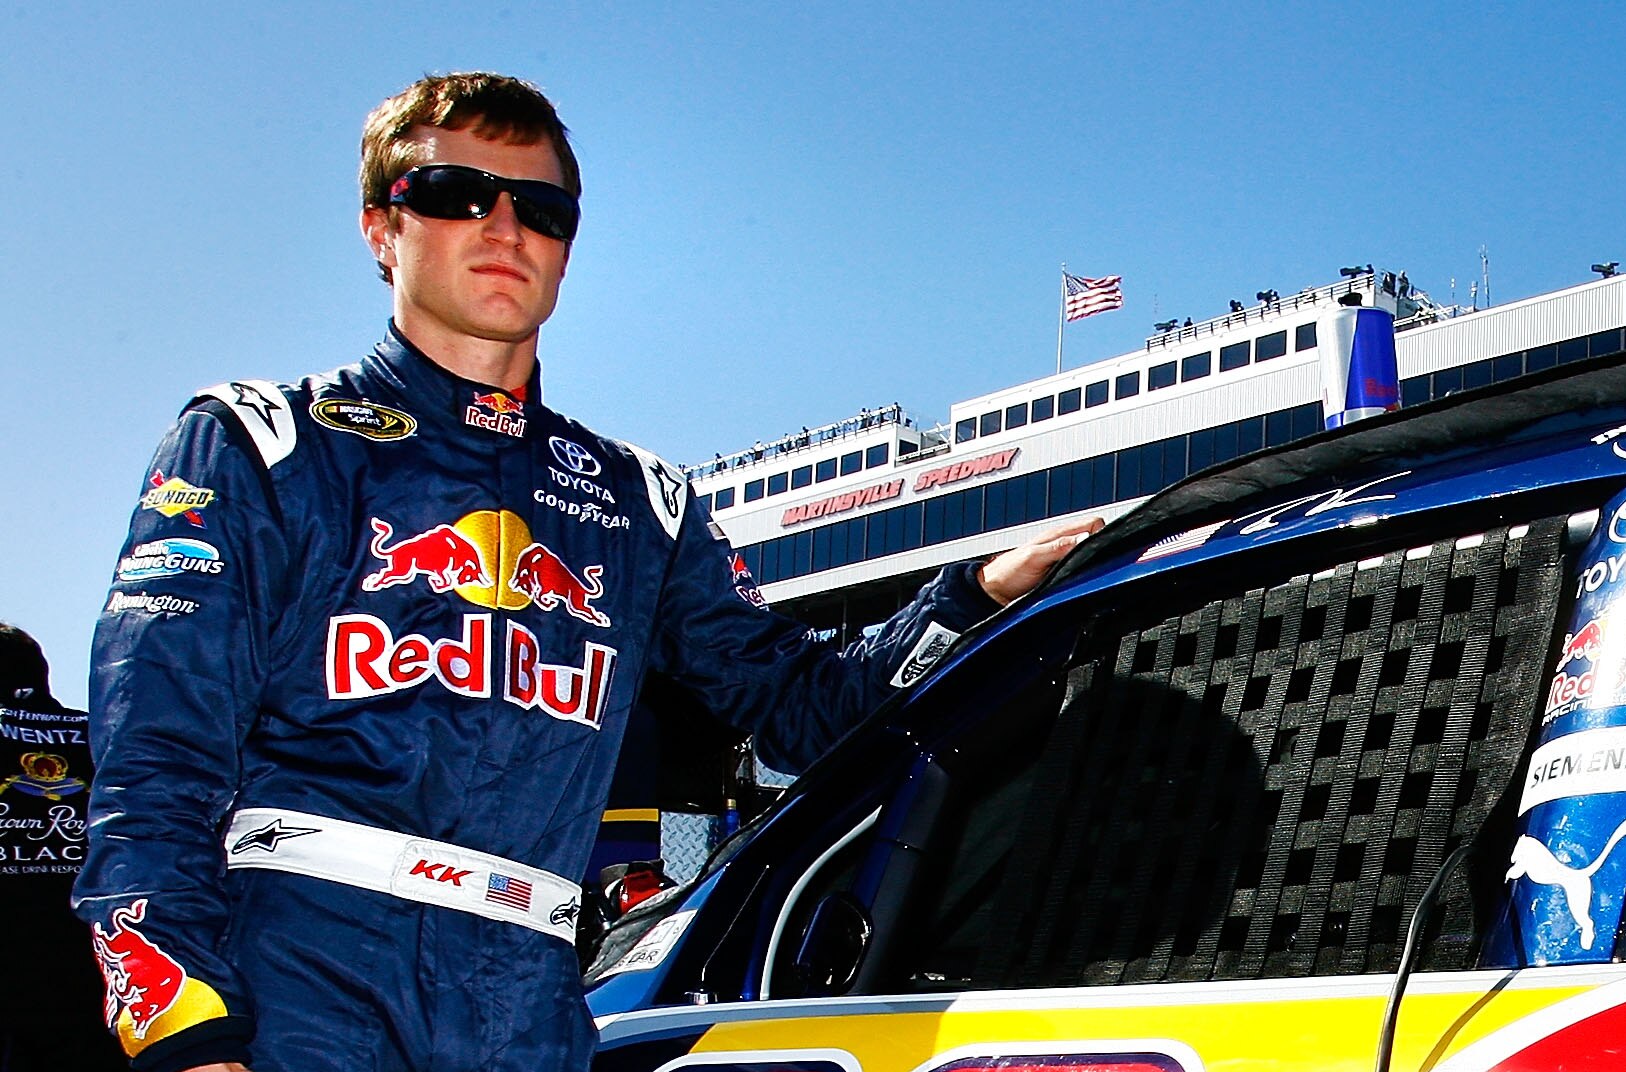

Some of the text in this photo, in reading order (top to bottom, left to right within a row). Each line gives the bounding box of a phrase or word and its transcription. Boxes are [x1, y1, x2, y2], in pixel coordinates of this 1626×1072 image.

[466, 406, 528, 438] Red Bull
[147, 489, 210, 507] SUNOCO
[548, 466, 616, 504] TOYOTA
[781, 447, 1020, 527] MARTINSVILLE SPEEDWAY
[107, 591, 197, 614] Remington
[329, 615, 489, 698] Red
[1549, 660, 1600, 707] Red
[1541, 696, 1594, 728] RACIN
[27, 805, 87, 842] Roy
[0, 846, 89, 861] BLAC
[408, 859, 475, 887] KK
